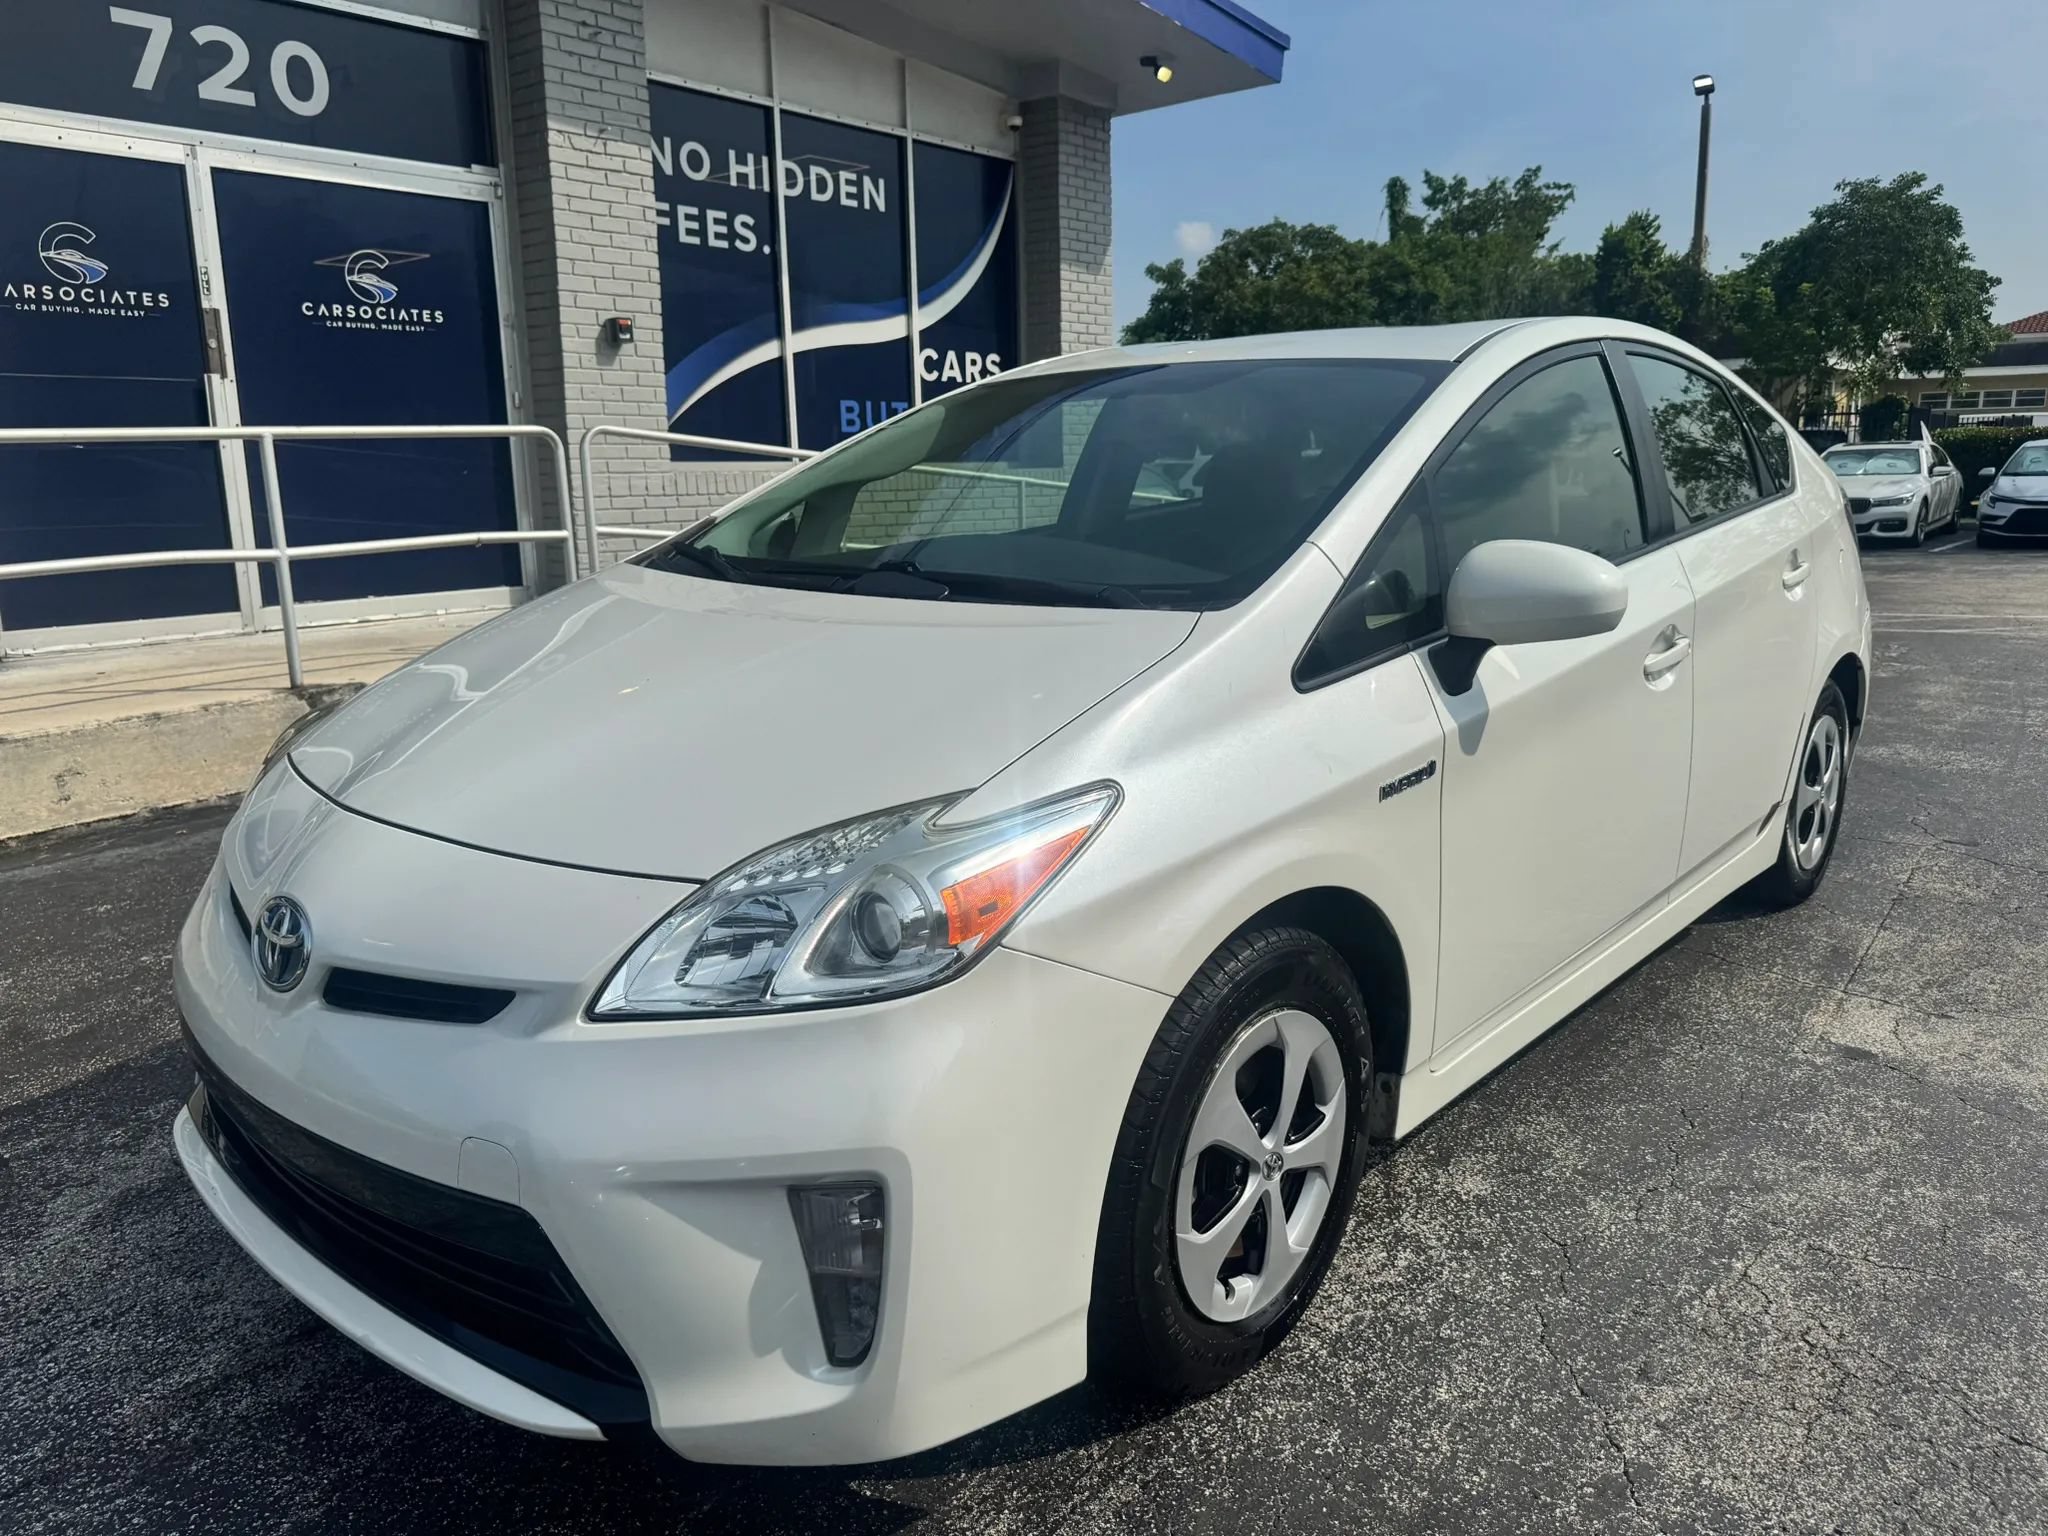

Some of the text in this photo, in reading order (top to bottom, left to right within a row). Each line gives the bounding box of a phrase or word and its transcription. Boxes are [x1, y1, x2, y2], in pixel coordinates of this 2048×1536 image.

[109, 6, 330, 117] 720
[650, 136, 887, 213] NO HIDDEN
[655, 201, 771, 255] FEES.
[15, 303, 36, 311] CAR
[88, 307, 116, 316] MADE
[120, 309, 146, 318] EASY
[301, 301, 444, 323] CARSOCIATES
[326, 320, 343, 328] CAR
[919, 347, 1001, 383] CARS
